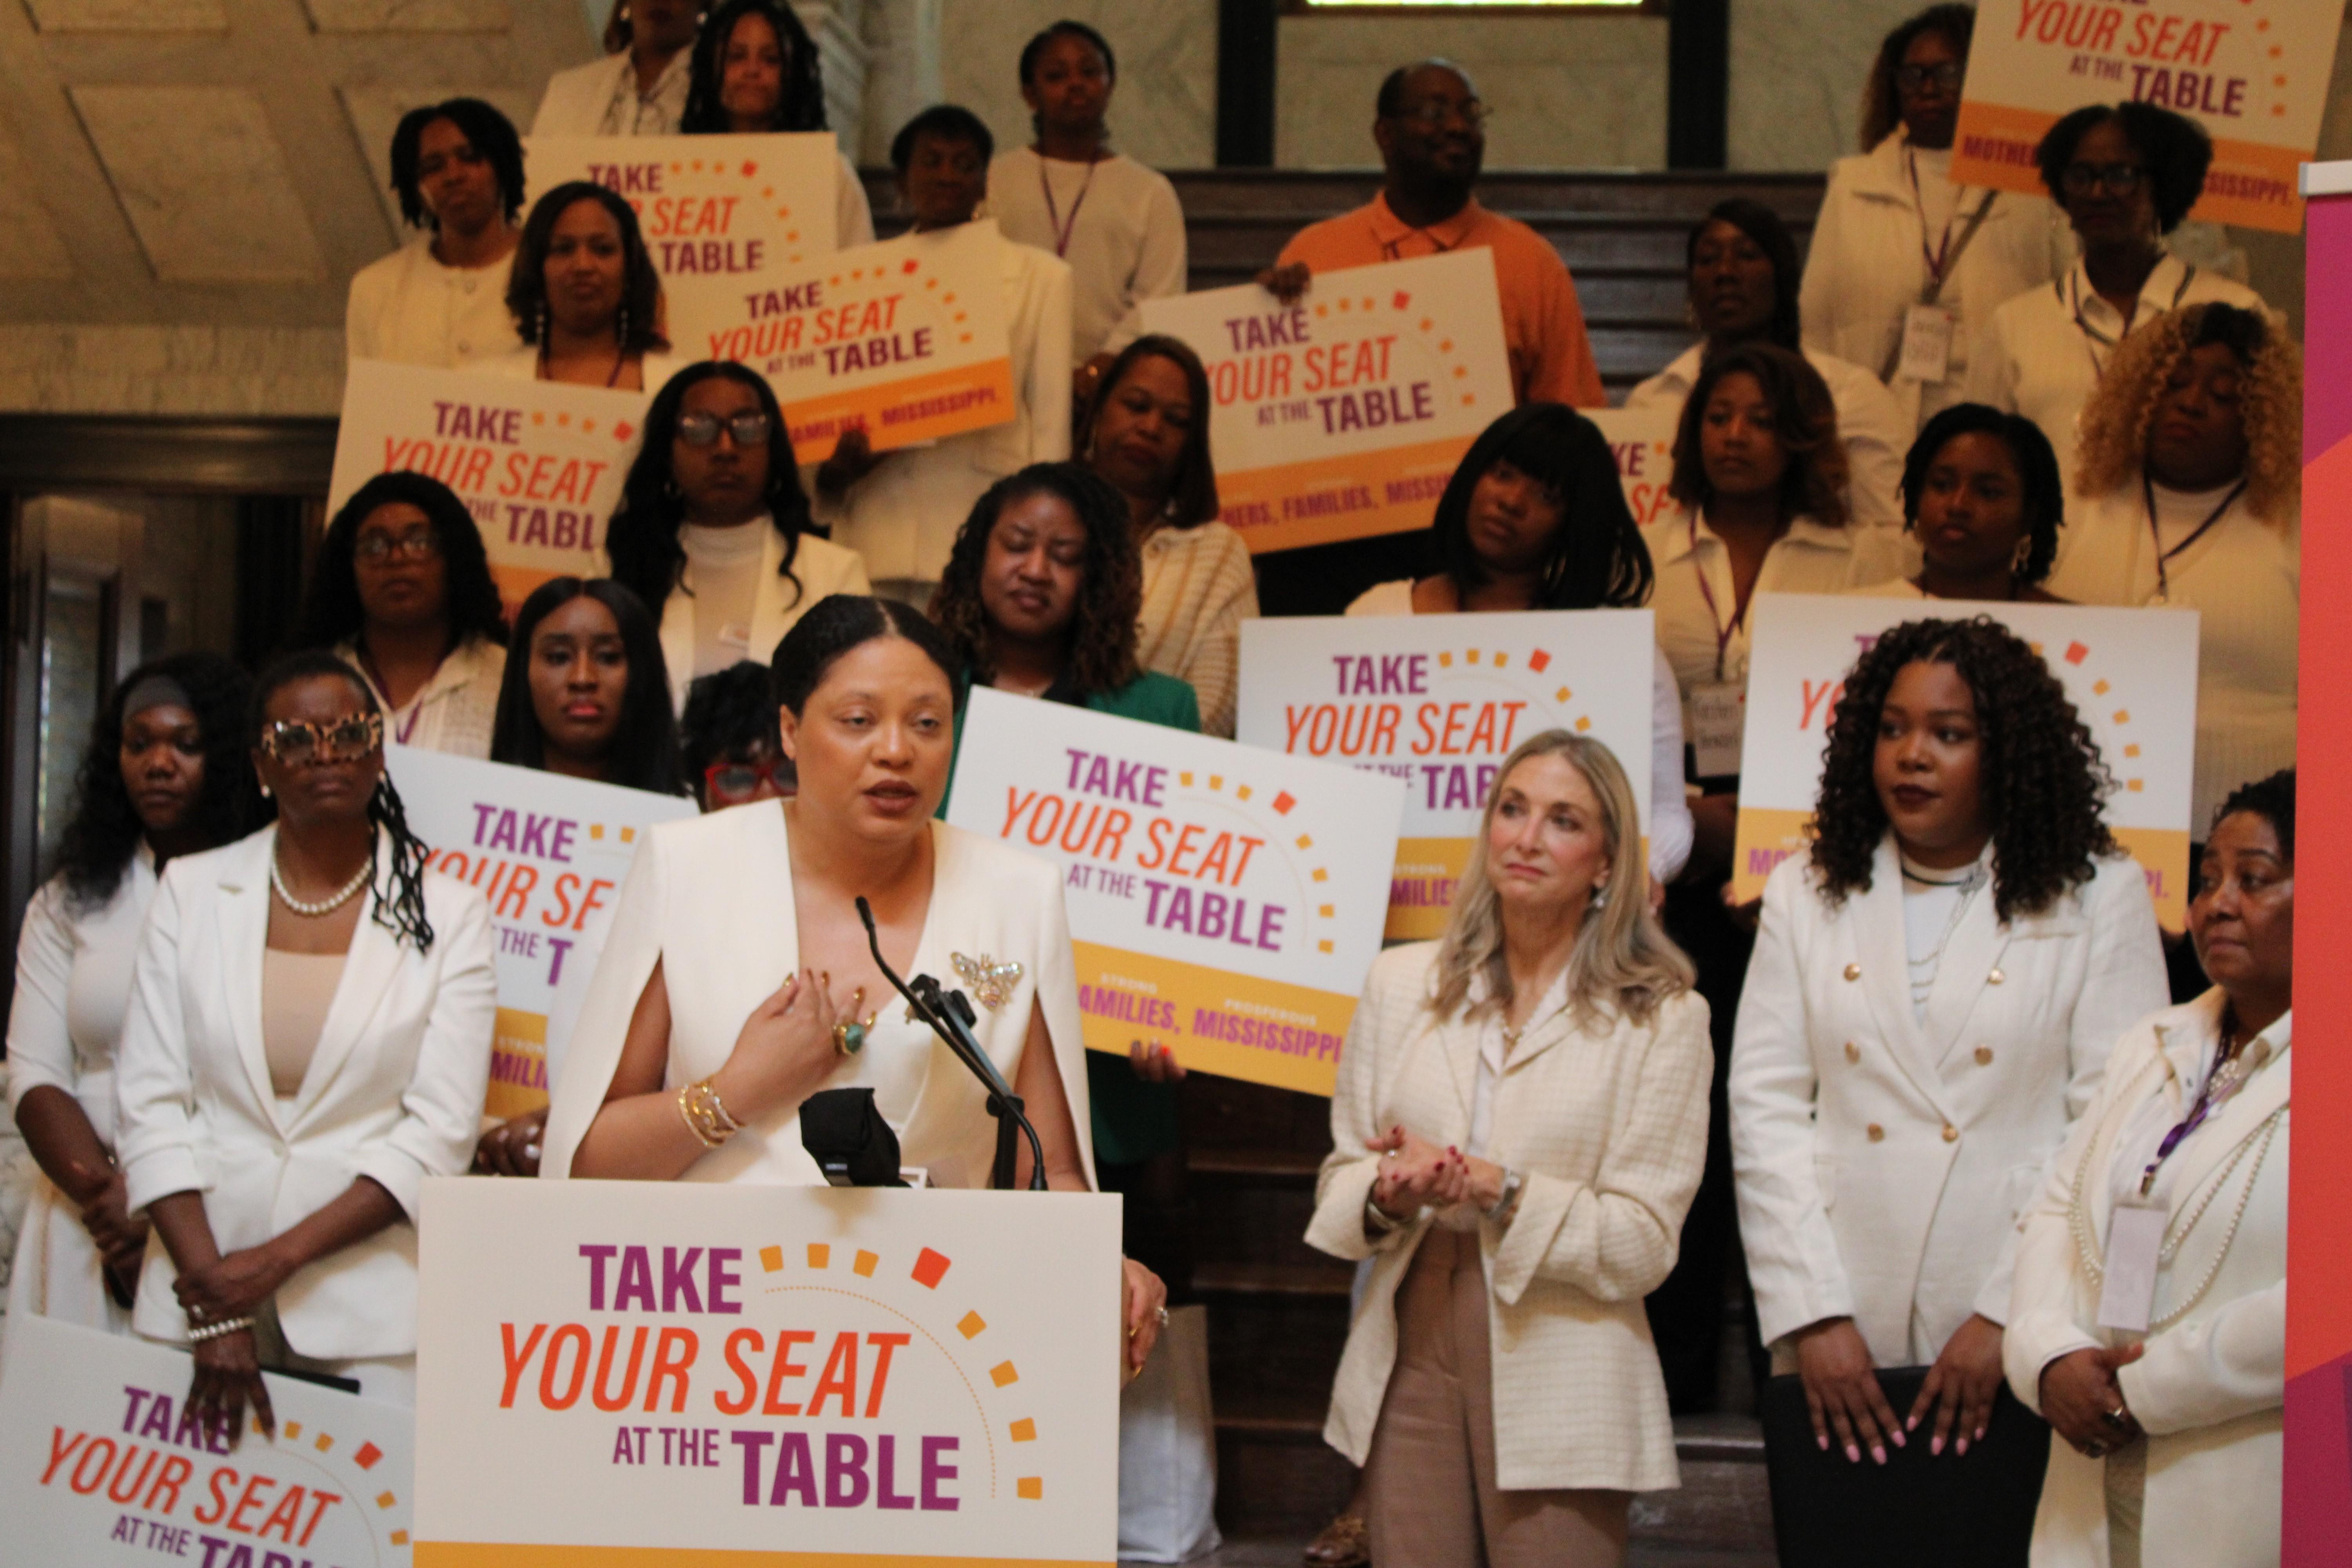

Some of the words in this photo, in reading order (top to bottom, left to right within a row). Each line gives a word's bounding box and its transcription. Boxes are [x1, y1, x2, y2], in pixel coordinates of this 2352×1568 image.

[2013, 0, 2123, 52] YOUR
[2125, 11, 2231, 67] SEAT
[2130, 63, 2247, 118] TABLE
[588, 163, 662, 193] TAKE
[649, 196, 740, 236] SEAT
[659, 240, 763, 274] TABLE
[745, 281, 824, 319] TAKE
[707, 316, 804, 363] YOUR
[812, 293, 903, 347] SEAT
[824, 328, 934, 377] TABLE
[1225, 306, 1310, 353] TAKE
[1206, 352, 1293, 407] OUR
[1303, 336, 1397, 392] SEAT
[434, 400, 522, 445] TAKE
[1316, 382, 1434, 435] TABLE
[384, 436, 494, 492] YOUR
[497, 450, 608, 506] SEAT
[505, 503, 595, 552] TABL
[1332, 654, 1428, 695] TAKE
[1285, 702, 1402, 756] YOUR
[1410, 701, 1527, 755] SEAT
[1065, 748, 1169, 809] TAKE
[1420, 764, 1500, 810] TAB
[472, 802, 577, 863] TAKE
[1000, 785, 1132, 862] YOUR
[1136, 817, 1265, 887] SEAT
[541, 872, 615, 932] SE
[1067, 863, 1095, 890] AT
[1098, 867, 1135, 899] THE
[1143, 879, 1287, 951] TABLE
[1390, 878, 1460, 907] MILIE
[501, 926, 541, 958] THE
[1078, 984, 1180, 1035] AMILIES,
[579, 1244, 742, 1314] TAKE
[498, 1322, 699, 1412] YOUR
[713, 1328, 911, 1418] SEAT
[40, 1426, 193, 1515] YOUR
[194, 1466, 343, 1548] SEAT
[612, 1425, 652, 1466] AT
[658, 1427, 720, 1467] THE
[731, 1430, 960, 1511] TABLE
[111, 1515, 143, 1544] AT
[148, 1521, 192, 1557] THE
